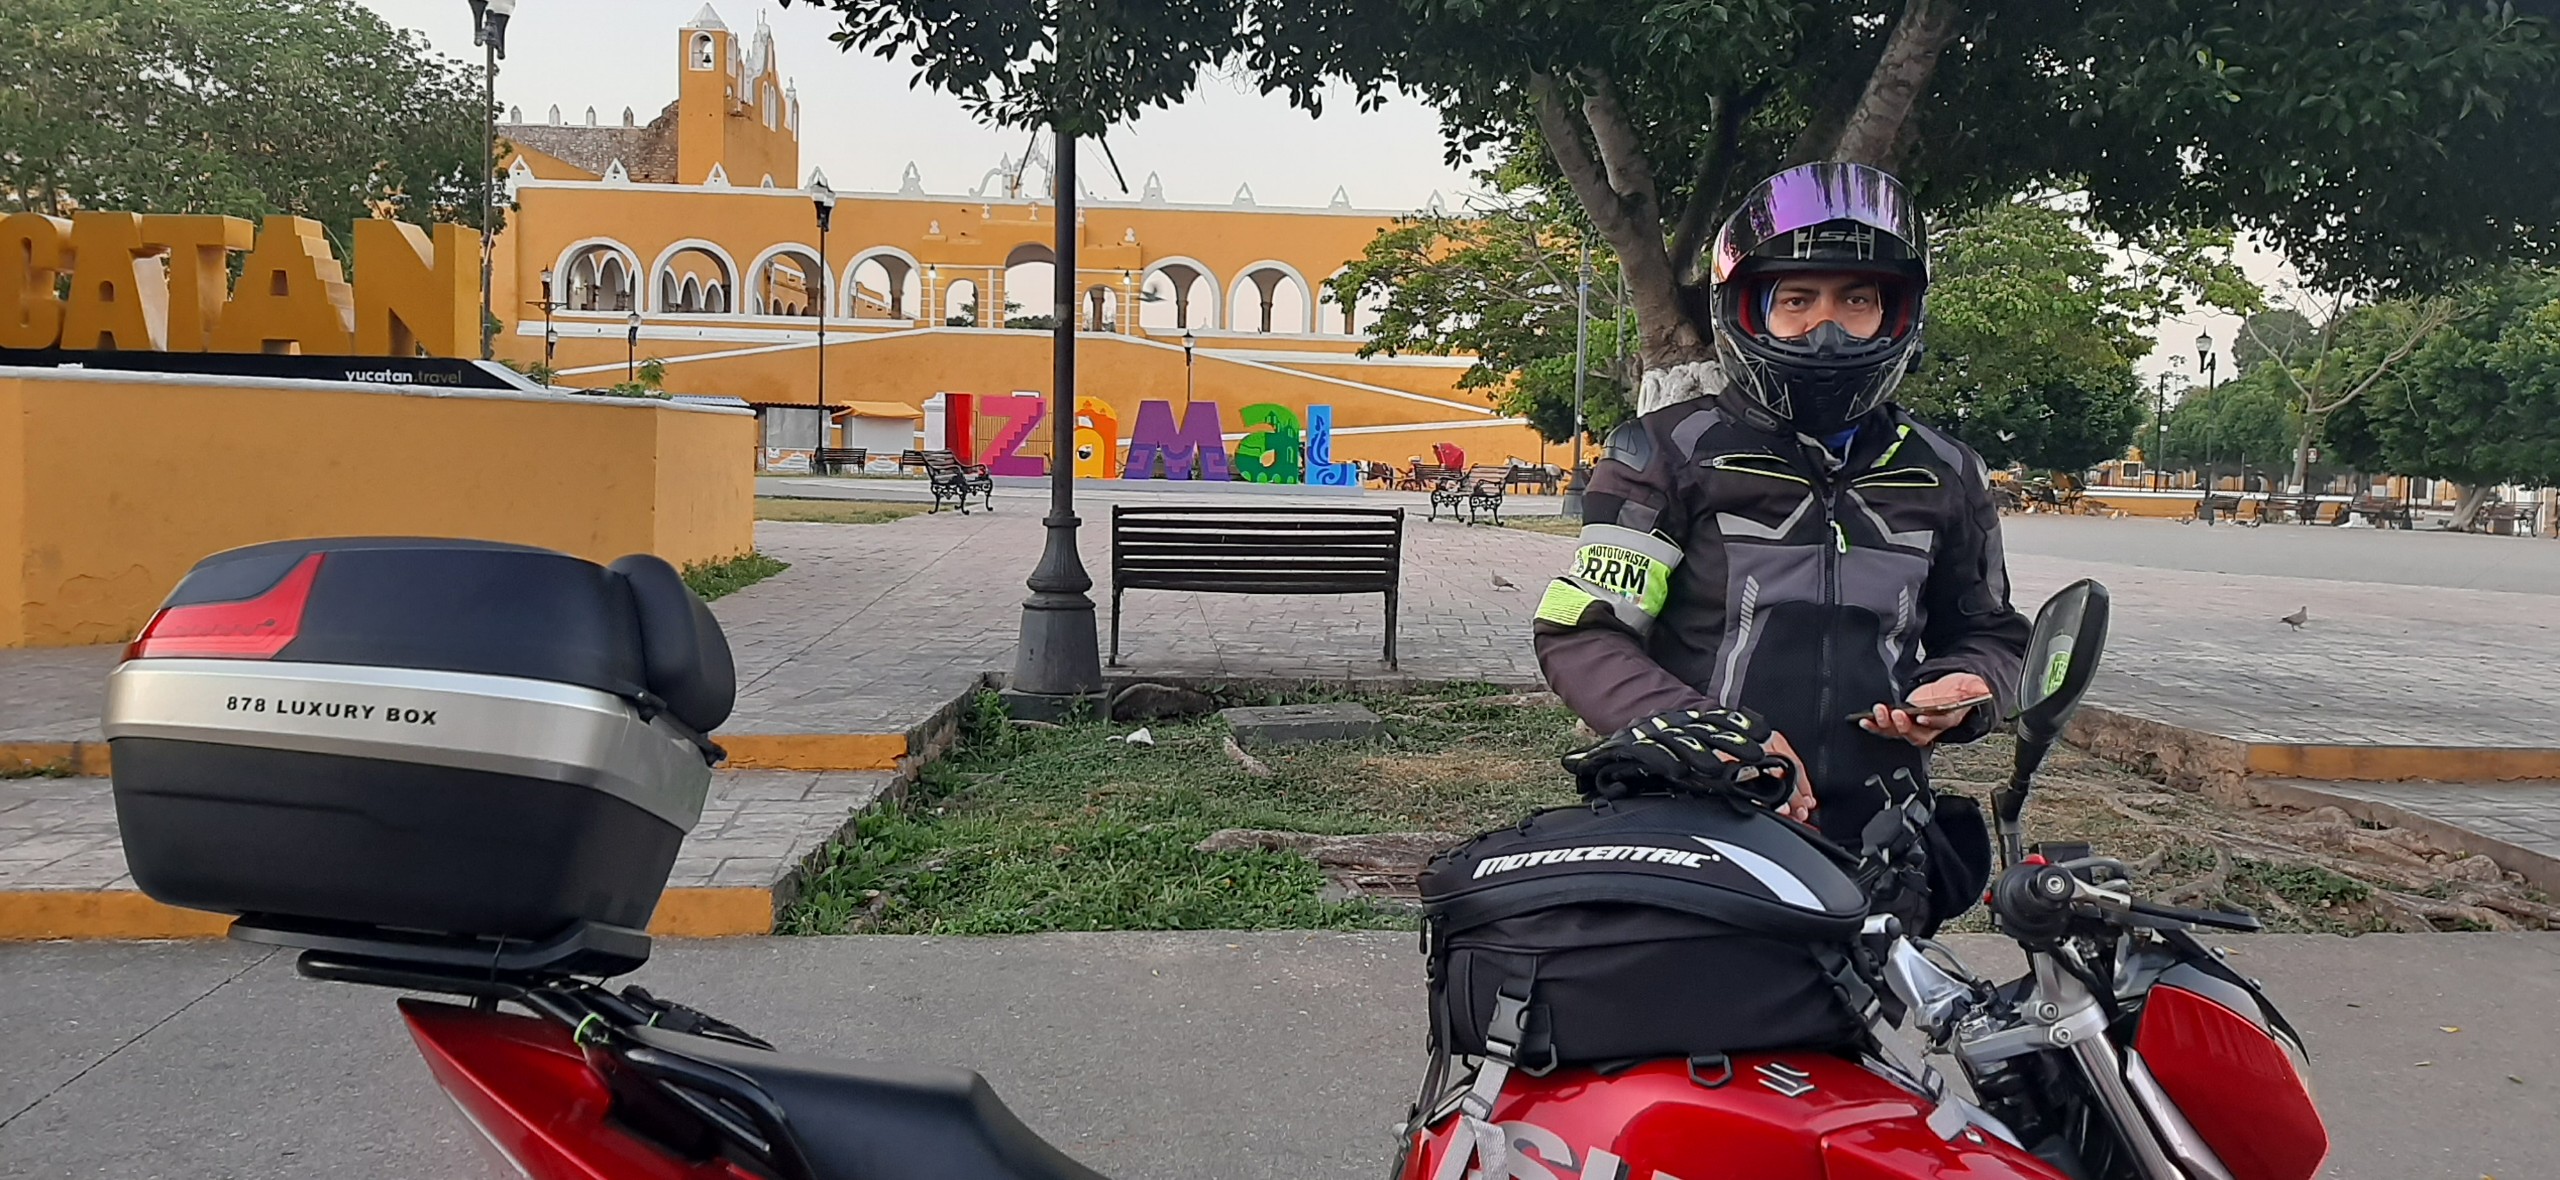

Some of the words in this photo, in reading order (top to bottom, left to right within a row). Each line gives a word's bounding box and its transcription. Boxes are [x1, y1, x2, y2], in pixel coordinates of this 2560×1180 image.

[1797, 231, 1872, 244] LS2
[345, 369, 462, 383] yucatan.travel
[1588, 545, 1650, 569] MOTOTURISTA
[1581, 557, 1647, 595] RRM
[226, 696, 266, 712] 878
[276, 700, 375, 719] LUXURY
[386, 708, 438, 725] BOX
[1472, 846, 1712, 880] MOTOCENTRIC
